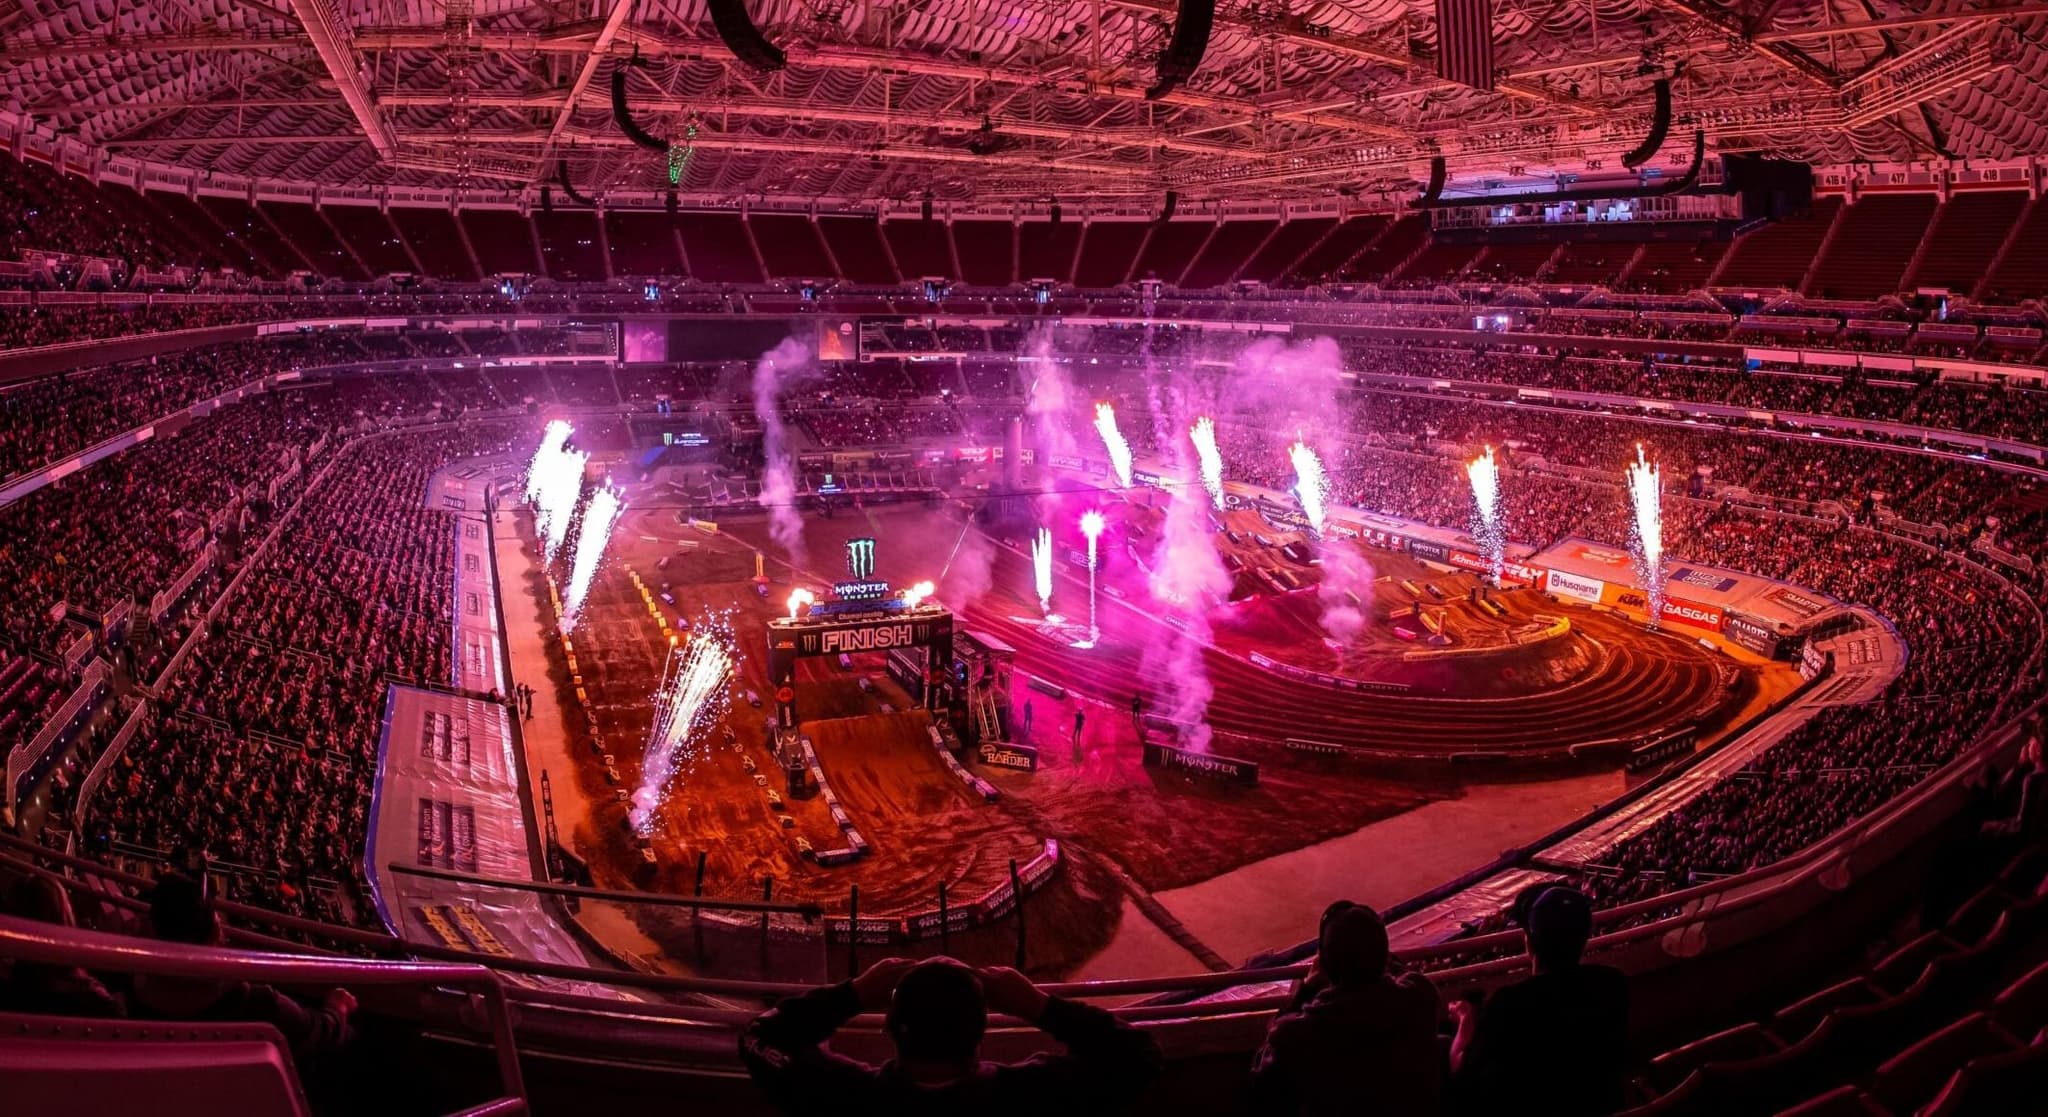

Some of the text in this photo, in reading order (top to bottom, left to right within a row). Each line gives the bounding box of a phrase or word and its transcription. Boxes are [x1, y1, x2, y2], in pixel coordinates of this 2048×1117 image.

[1825, 174, 1839, 186] 416
[1890, 173, 1905, 184] 417
[1983, 169, 1998, 181] 418
[835, 583, 889, 595] MONSTER
[1559, 578, 1599, 594] Husqvarna
[1617, 594, 1645, 607] KTM
[1662, 602, 1719, 625] GASGAS
[822, 624, 912, 653] FINISH
[986, 752, 1031, 768] HARDER
[1175, 753, 1238, 777] MONSTER
